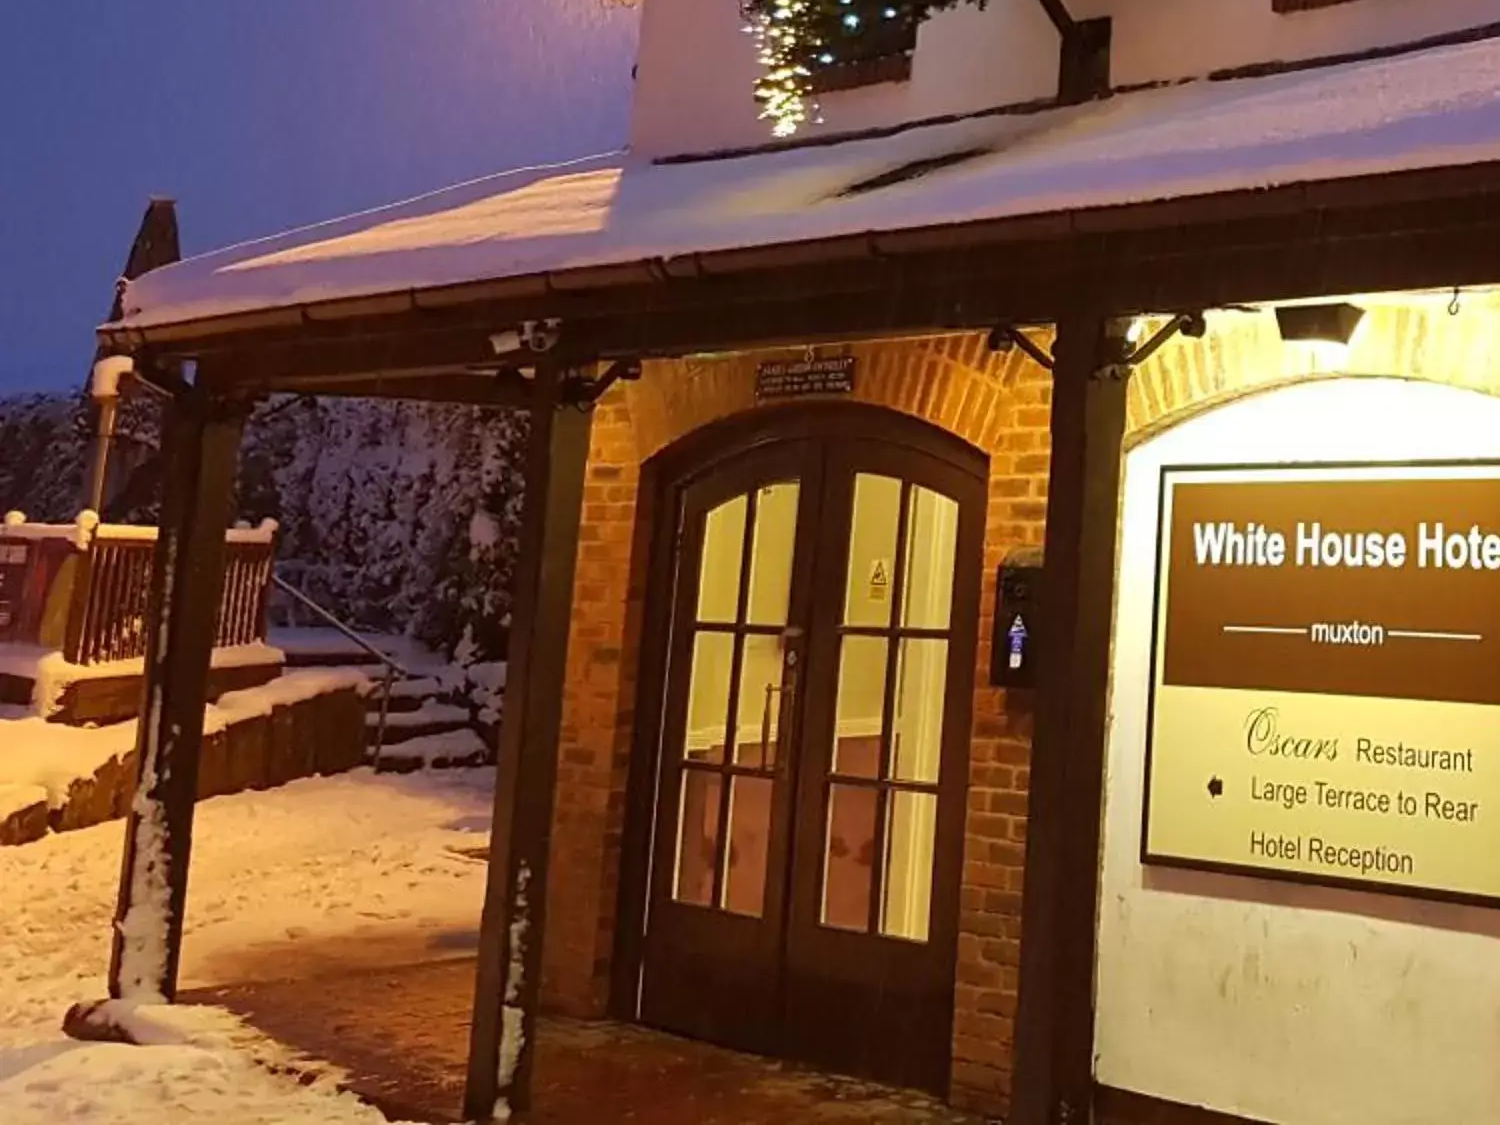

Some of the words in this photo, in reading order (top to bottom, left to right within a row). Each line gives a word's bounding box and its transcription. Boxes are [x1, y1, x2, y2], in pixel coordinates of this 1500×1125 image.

[1193, 522, 1285, 566] White
[1296, 522, 1406, 568] House
[1311, 620, 1383, 645] muxton
[1243, 707, 1339, 761] Oscars
[1356, 738, 1473, 772] Restaurant
[1251, 776, 1307, 809] Large
[1315, 781, 1390, 814] Terrace
[1397, 791, 1417, 816] to
[1424, 792, 1478, 823] Rear
[1250, 831, 1302, 860] Hotel
[1308, 838, 1413, 875] Reception
